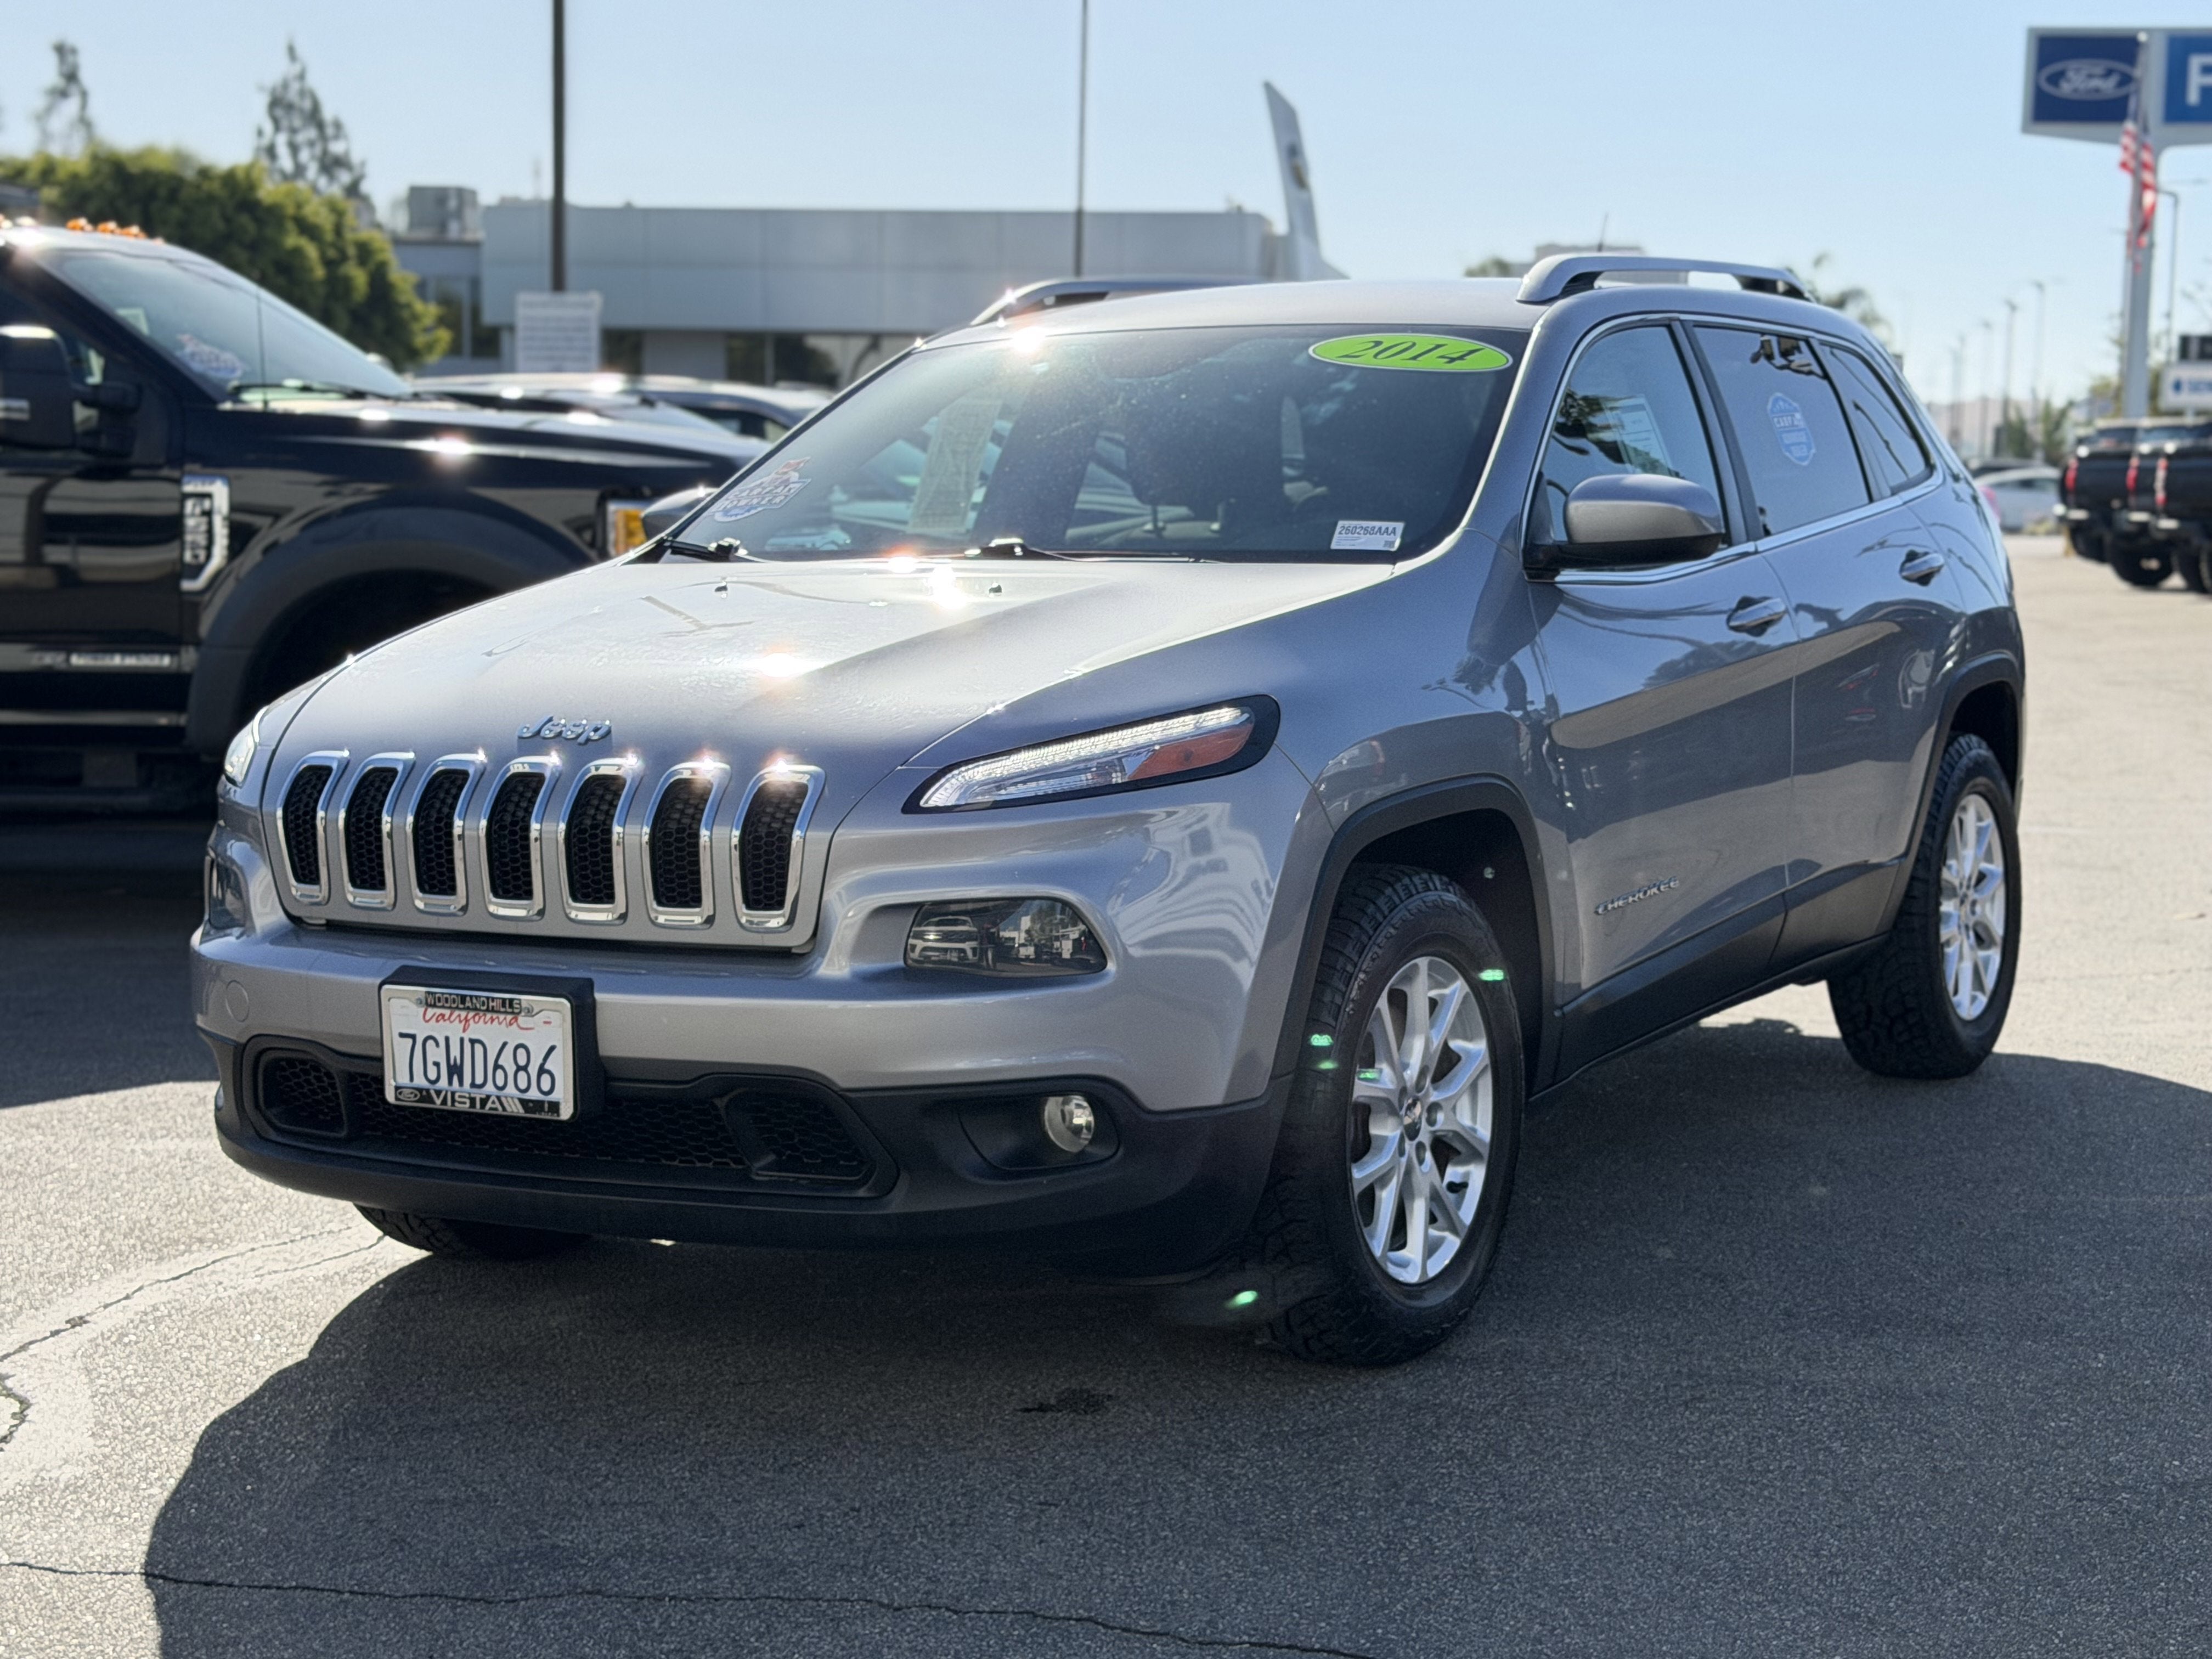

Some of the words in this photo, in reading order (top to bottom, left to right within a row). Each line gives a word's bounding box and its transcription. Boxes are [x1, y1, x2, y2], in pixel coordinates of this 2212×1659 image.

[1336, 340, 1485, 365] 2014
[517, 715, 612, 745] Jeep
[426, 992, 487, 1009] WOODLAND
[489, 999, 521, 1013] HILLS
[422, 1007, 535, 1033] California
[398, 1032, 557, 1096] 7GWD686
[430, 1089, 504, 1111] VISTA
